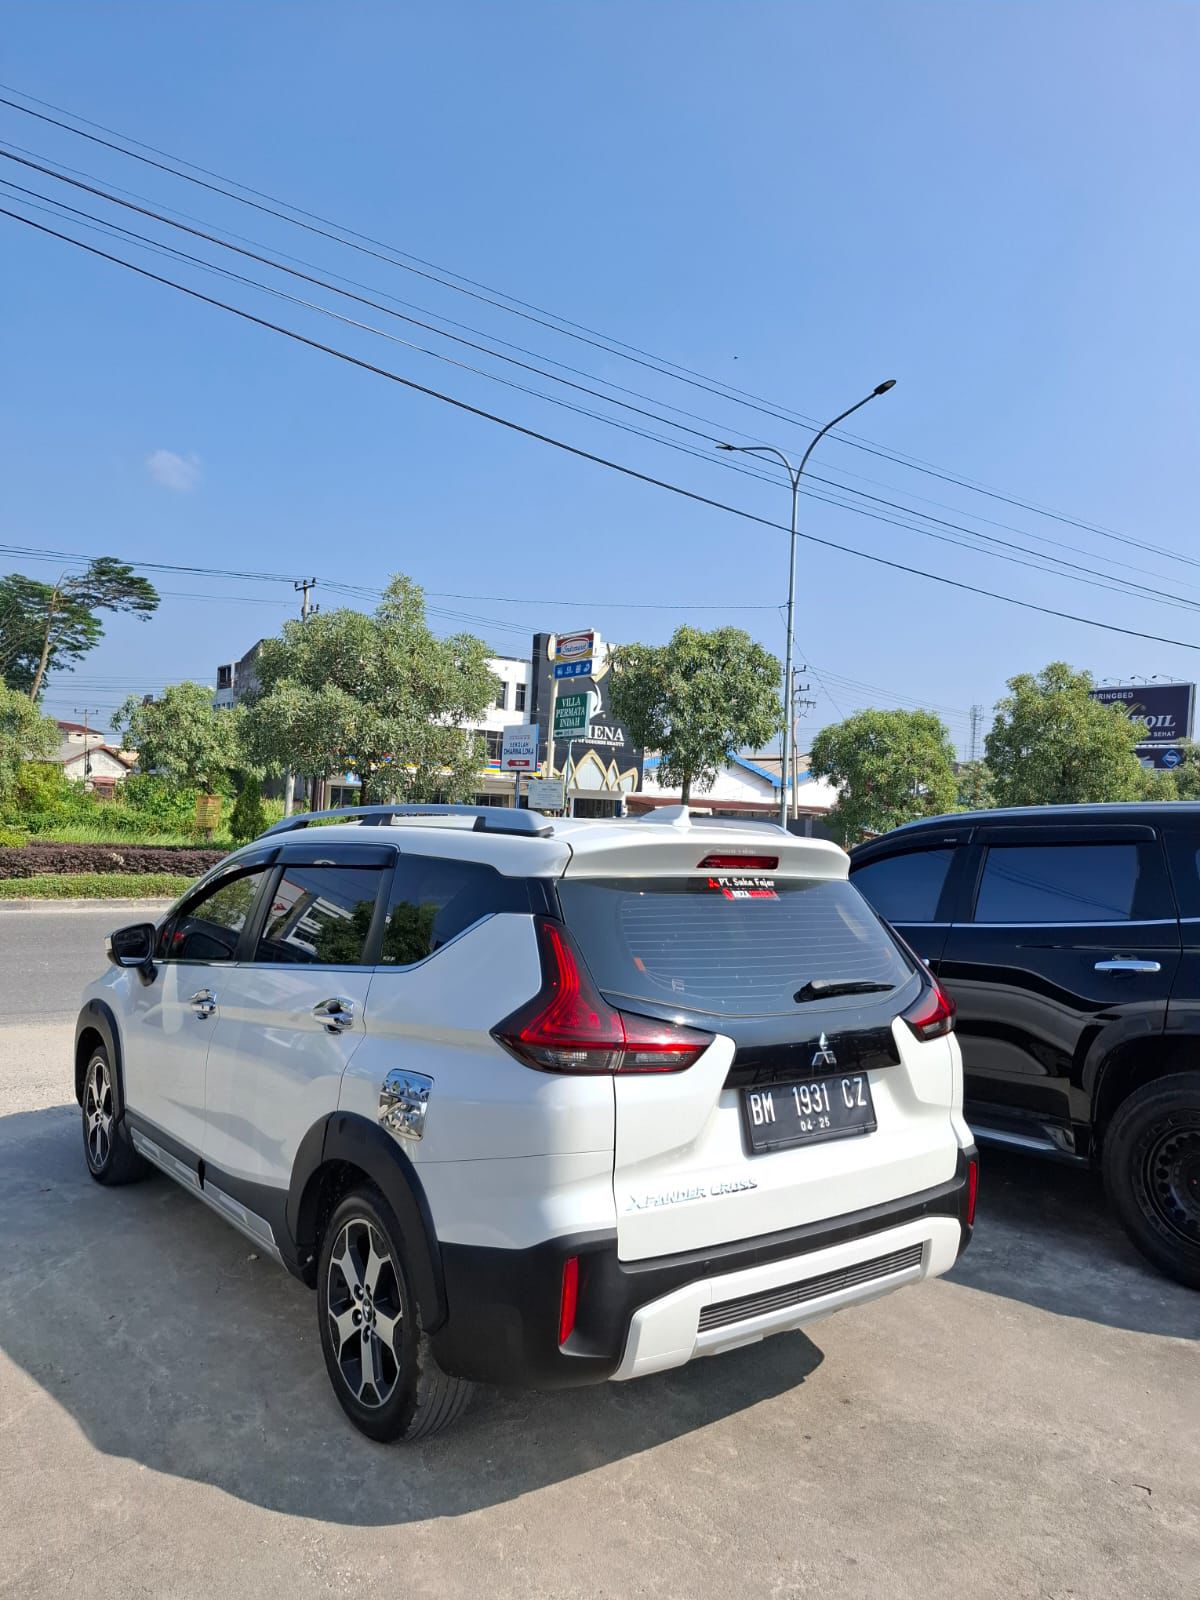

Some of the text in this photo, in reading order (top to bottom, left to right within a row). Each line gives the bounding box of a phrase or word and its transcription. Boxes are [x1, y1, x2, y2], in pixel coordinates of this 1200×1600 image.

[562, 696, 581, 707] VILLA
[556, 707, 585, 718] PERMATA
[560, 717, 580, 727] INDAH
[750, 1077, 867, 1125] BM 1931 CZ
[710, 1178, 758, 1196] CROSS
